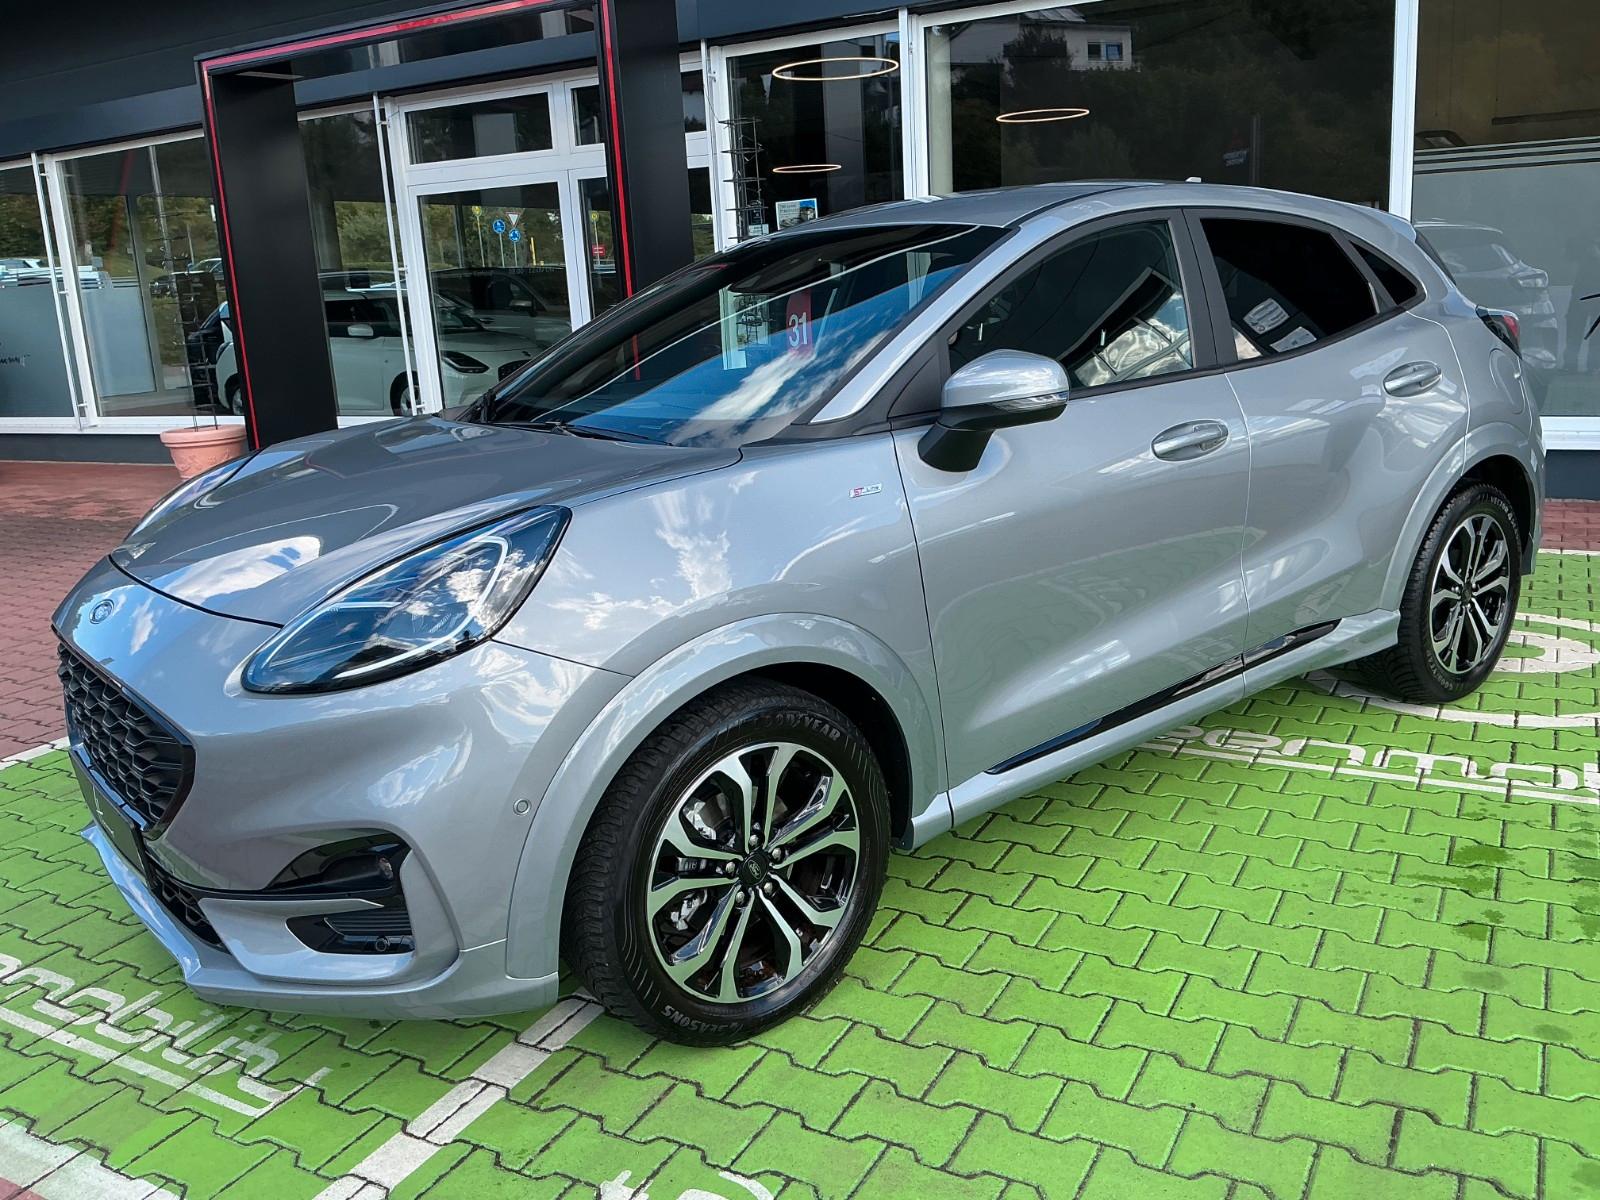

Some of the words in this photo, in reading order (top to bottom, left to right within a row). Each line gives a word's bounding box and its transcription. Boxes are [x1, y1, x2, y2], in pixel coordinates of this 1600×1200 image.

[788, 311, 808, 348] 31
[753, 712, 841, 742] OODYEAR
[0, 952, 332, 1117] mobility
